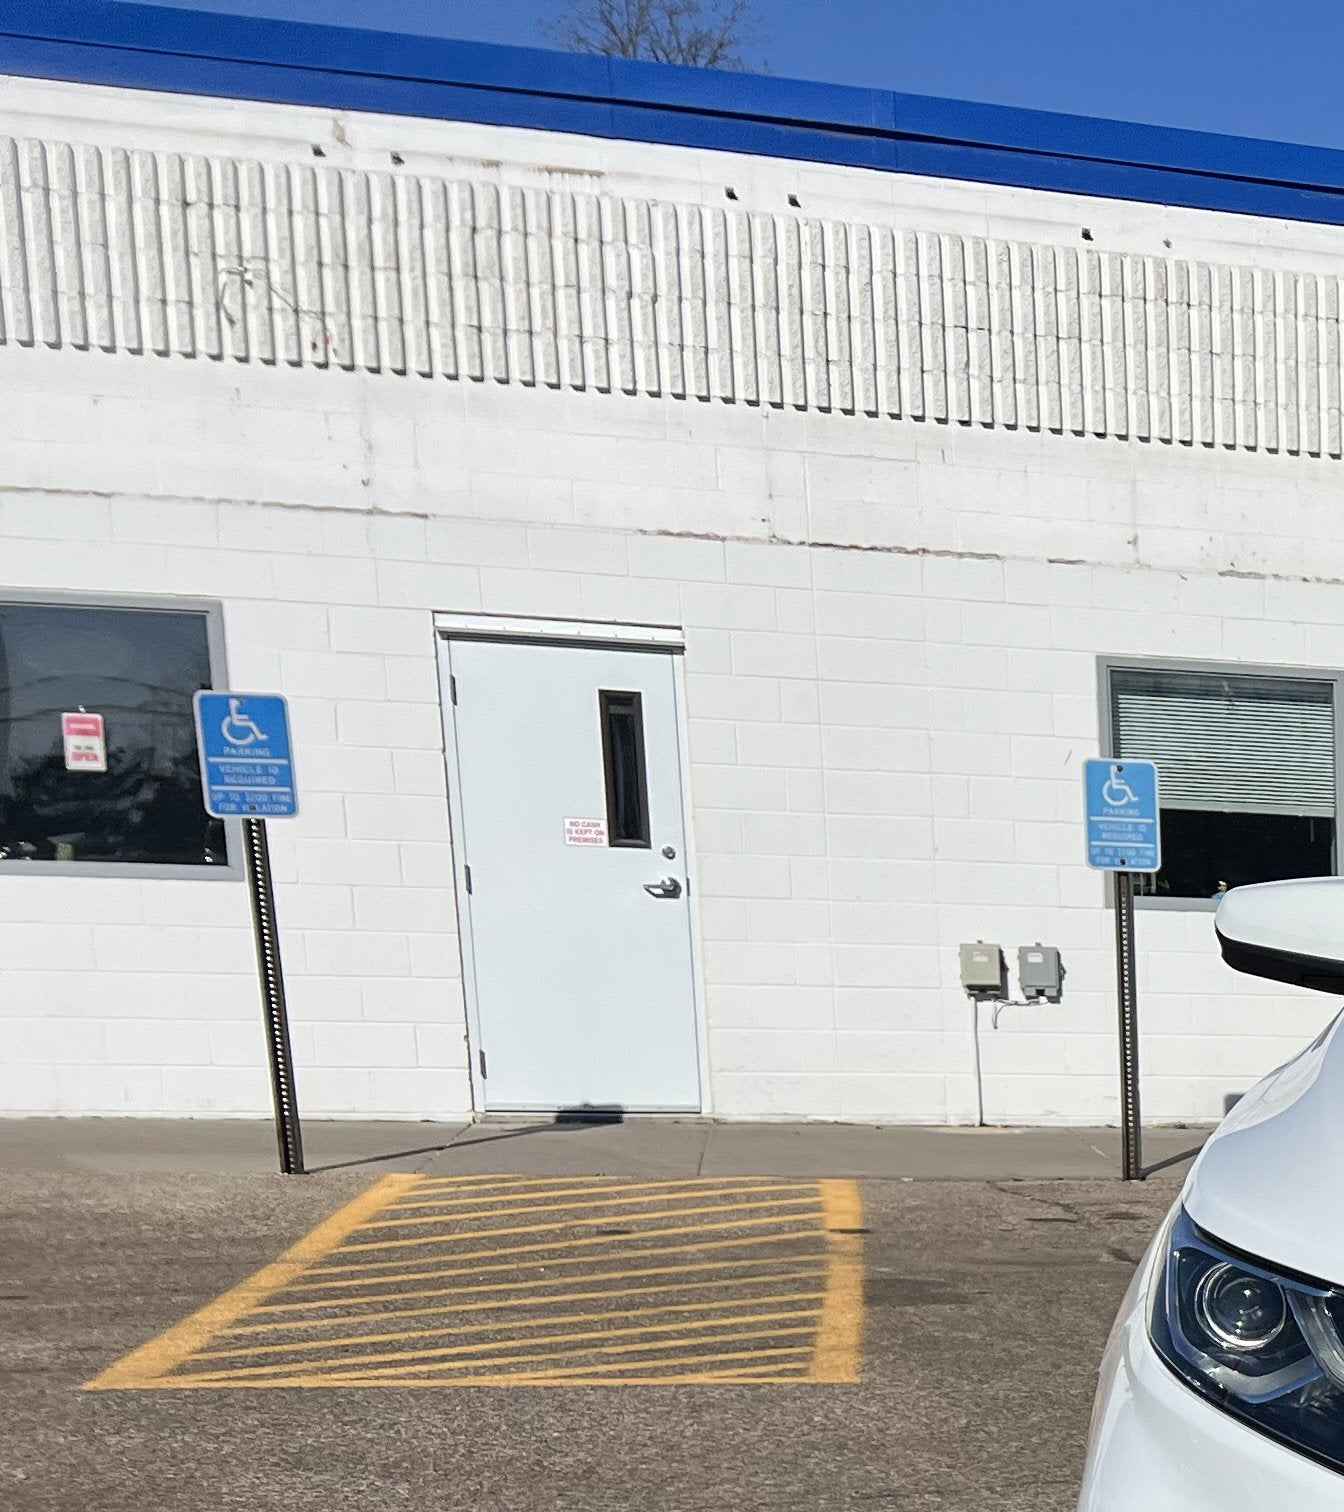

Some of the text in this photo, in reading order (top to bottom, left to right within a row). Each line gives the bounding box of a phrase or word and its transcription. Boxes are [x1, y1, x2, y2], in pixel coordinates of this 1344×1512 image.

[223, 746, 271, 757] PARKING
[219, 764, 279, 774] VEHICLE ID
[223, 774, 276, 785] REQUIRED
[242, 803, 288, 813] VLATION
[1103, 808, 1141, 817] PARKING
[575, 828, 592, 836] KEPT
[568, 836, 604, 844] PREMISES
